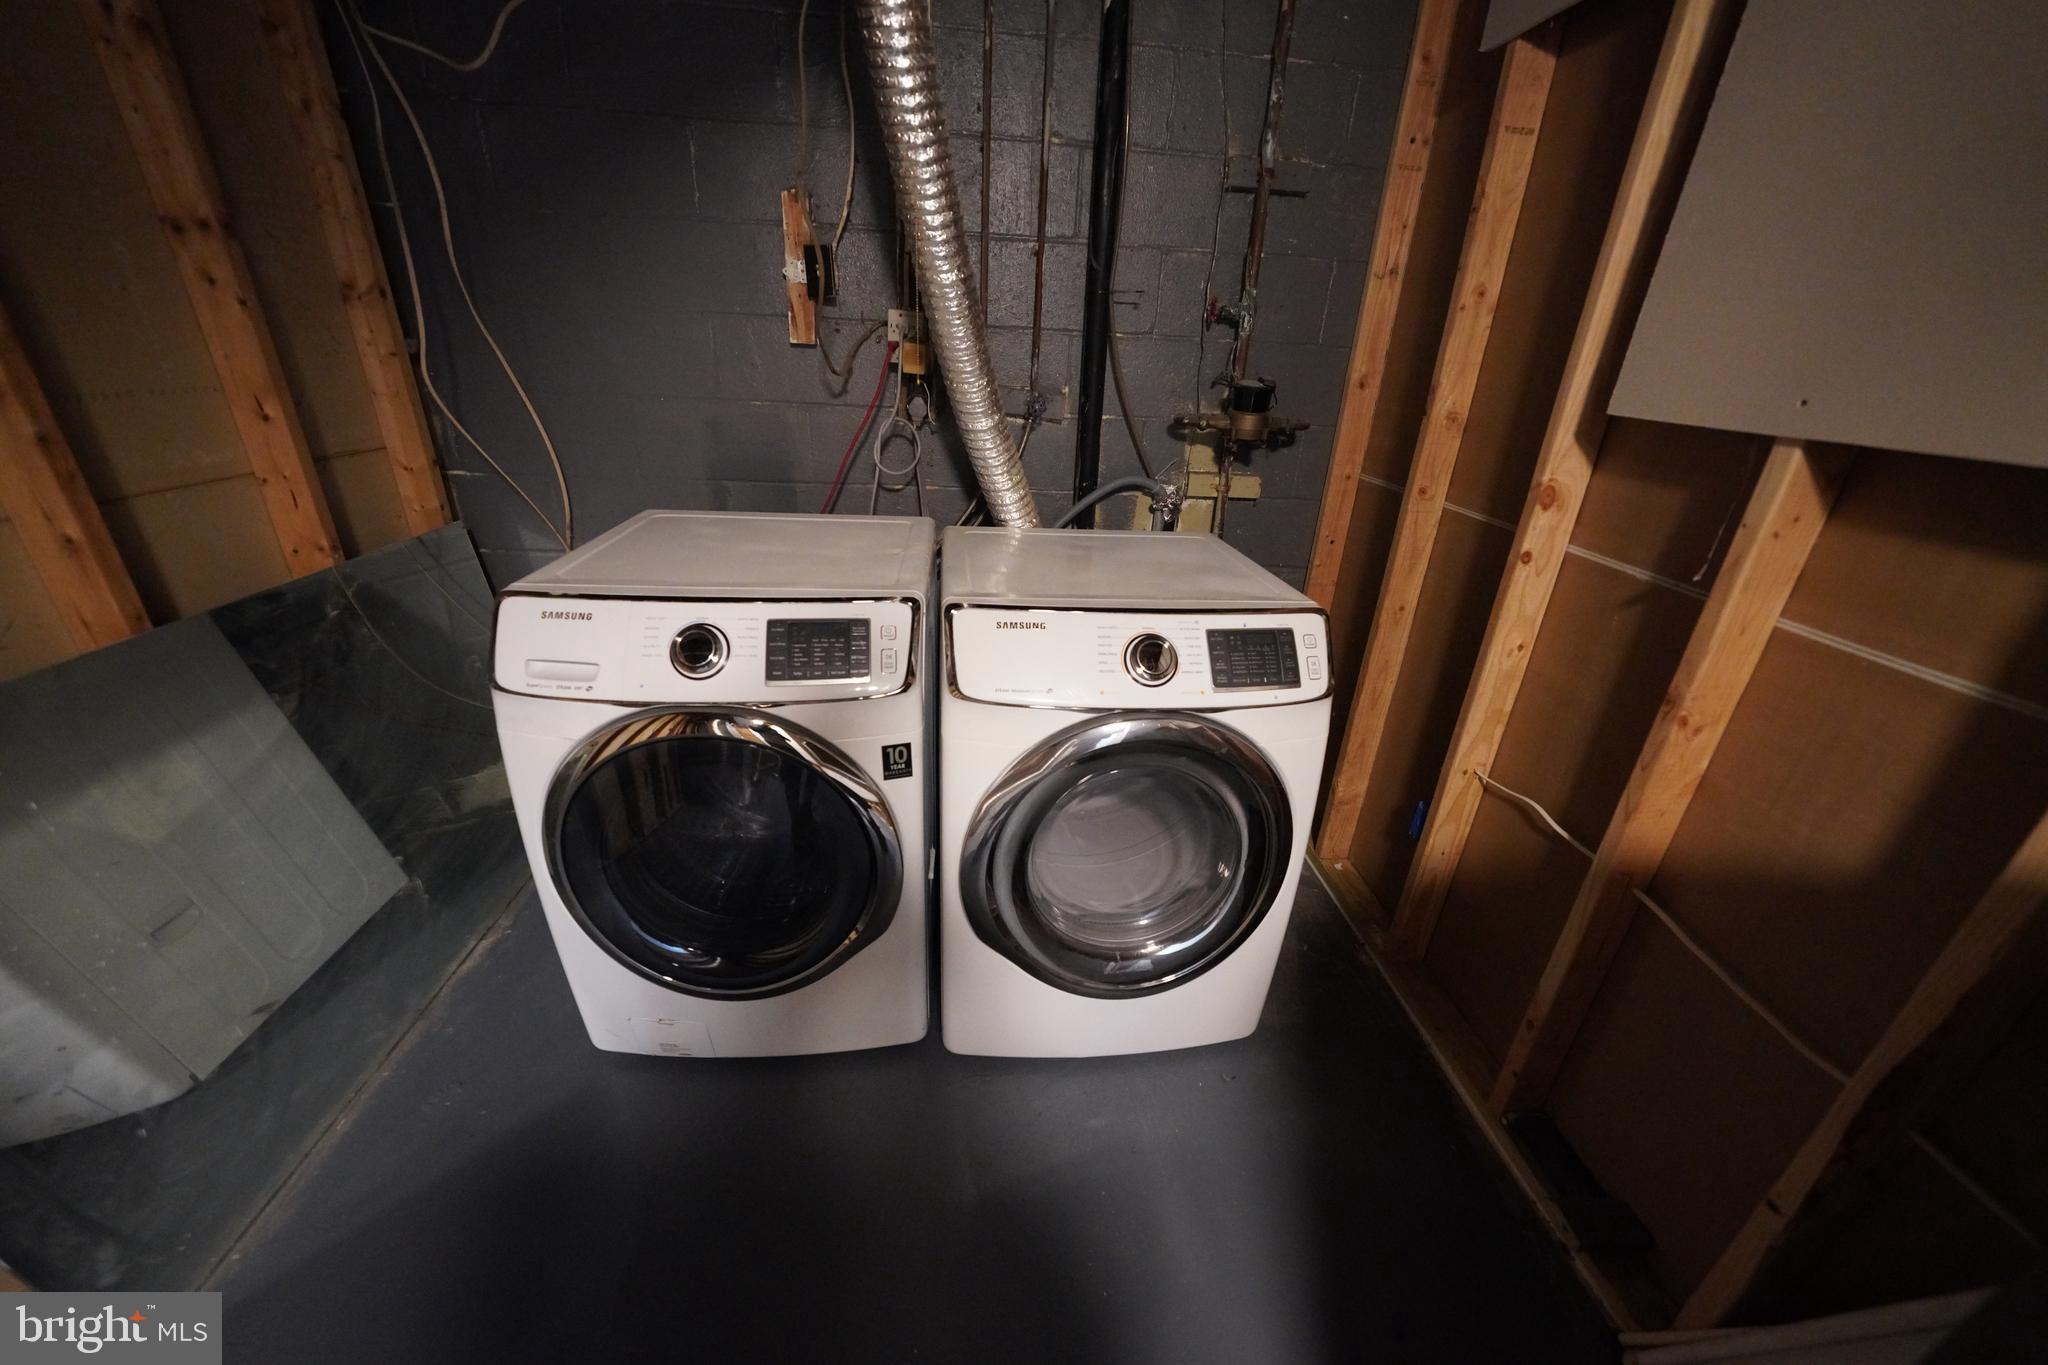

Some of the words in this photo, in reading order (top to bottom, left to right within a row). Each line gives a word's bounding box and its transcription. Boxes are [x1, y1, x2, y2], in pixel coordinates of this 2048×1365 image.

[540, 610, 593, 621] SAMSUNG
[995, 620, 1047, 630] SAMSUNG
[886, 746, 908, 764] 10
